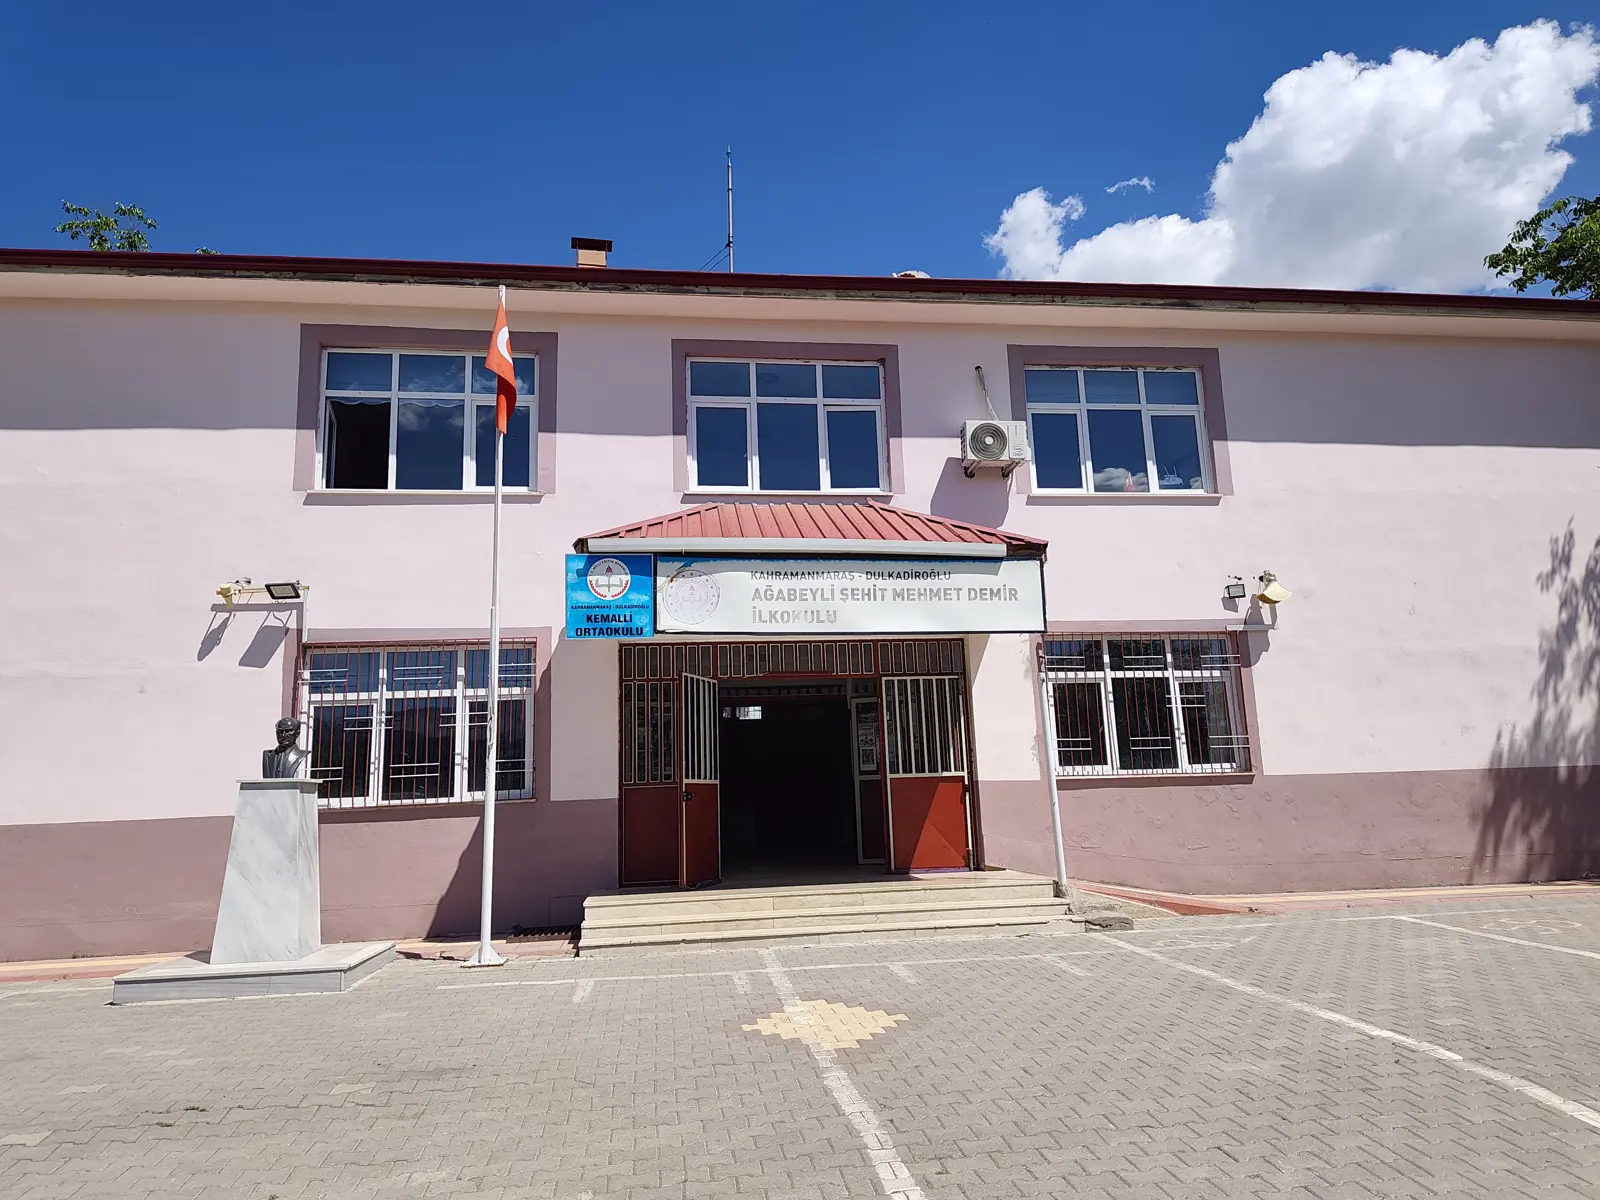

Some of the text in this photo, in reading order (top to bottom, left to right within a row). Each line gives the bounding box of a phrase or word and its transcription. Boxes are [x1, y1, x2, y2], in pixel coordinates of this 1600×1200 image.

[750, 570, 855, 582] KAHRAMANMARAŞ
[865, 568, 951, 581] DULKADİROĞLU
[751, 584, 1019, 603] AĞABEYLİ ŞEHİT MEHMET DEMİR
[586, 611, 633, 624] KEMALLİ
[751, 606, 838, 624] İLKOKULU
[575, 627, 644, 637] ORTAOKULU
